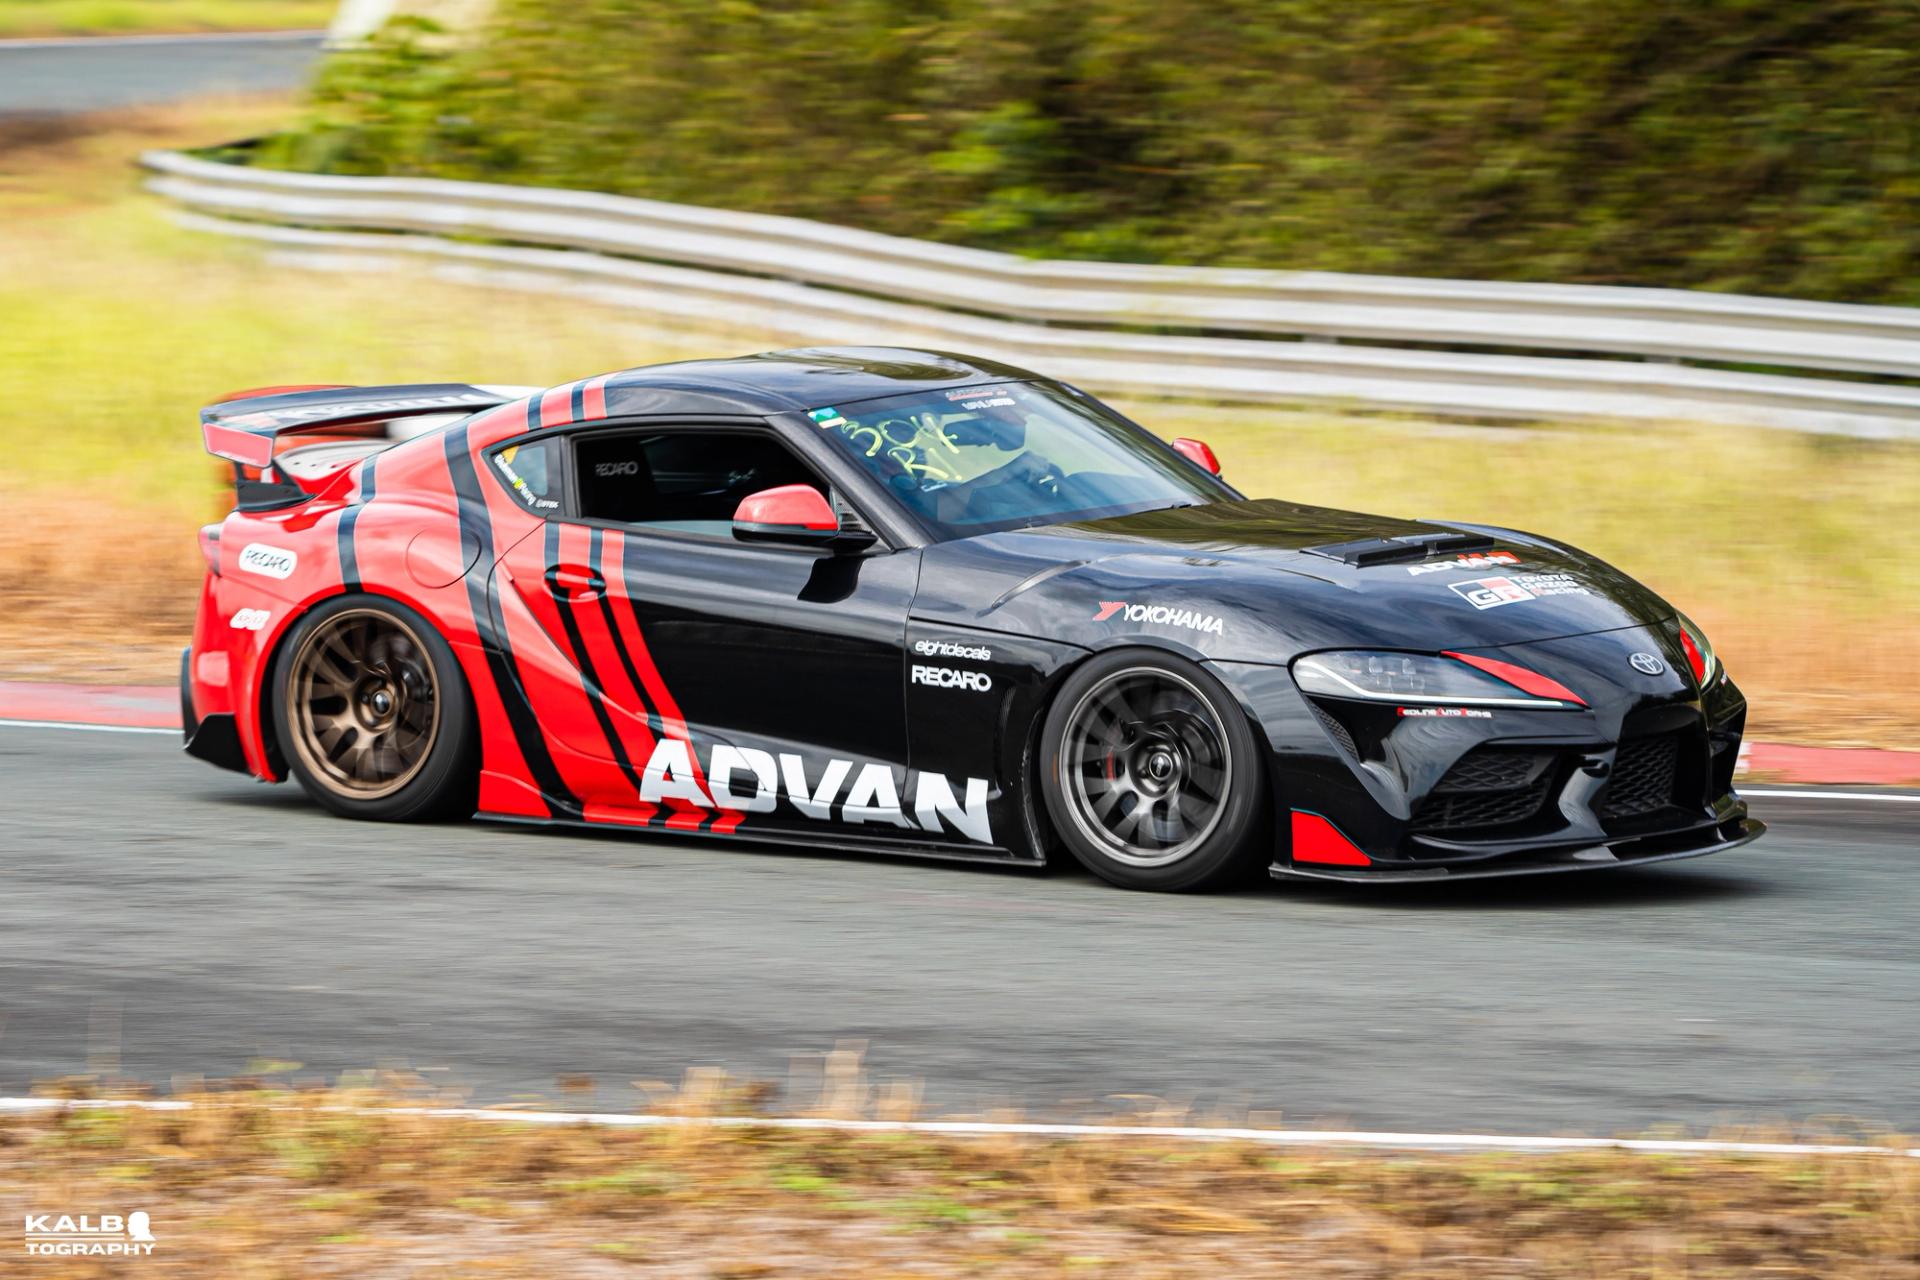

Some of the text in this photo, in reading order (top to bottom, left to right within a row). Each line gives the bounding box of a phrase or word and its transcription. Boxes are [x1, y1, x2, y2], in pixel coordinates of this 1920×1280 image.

[1407, 553, 1520, 576] ADVAN
[1509, 574, 1573, 584] TOYOTA
[1520, 581, 1579, 590] GAZOO
[1122, 604, 1225, 636] YOKOHAMA
[914, 639, 992, 661] eightdecals
[910, 665, 992, 692] RECARO
[639, 738, 993, 845] ADVAN
